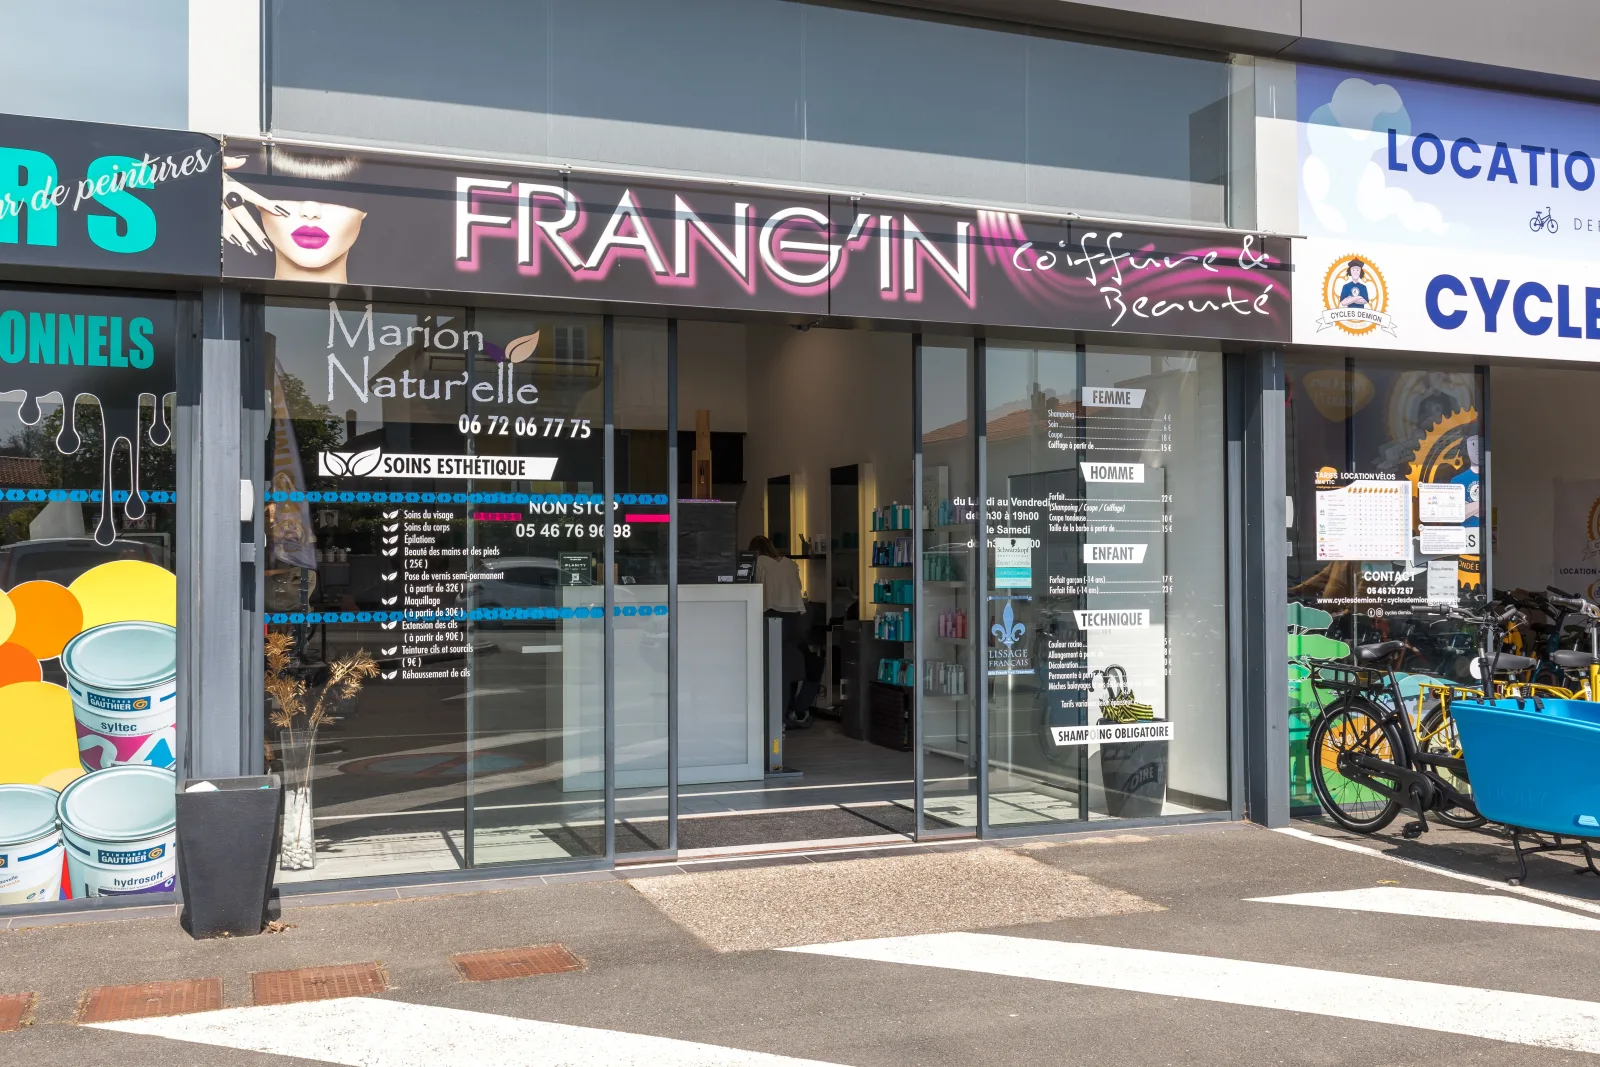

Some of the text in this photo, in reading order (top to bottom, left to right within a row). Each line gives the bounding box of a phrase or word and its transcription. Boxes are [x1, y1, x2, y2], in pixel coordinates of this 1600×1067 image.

[1388, 128, 1595, 191] LOCATIO
[31, 148, 213, 212] de peintures
[455, 176, 974, 304] FRANG'IN
[1013, 232, 1268, 286] Coiffure &
[1100, 284, 1273, 327] Beauté
[1330, 310, 1382, 322] CYCLES DEMION
[327, 301, 483, 352] Marion
[327, 352, 539, 405] Natur'elle
[1092, 390, 1131, 405] FEMME
[1048, 410, 1075, 420] Shampoing
[458, 414, 591, 439] 06 72 06 77 75
[1048, 431, 1063, 440] Coupe
[1048, 440, 1068, 451] Coiffage
[1073, 442, 1087, 451] partir
[384, 456, 526, 476] SOINS ESTHÉTIQUE
[1090, 466, 1134, 480] HOMME
[1341, 472, 1375, 480] LOCATION
[1375, 472, 1396, 480] VÉLOS
[954, 497, 965, 506] du
[968, 497, 994, 506] Ldi
[1010, 498, 1050, 506] Vendredi
[1049, 492, 1065, 500] Forfait
[529, 501, 567, 514] NON
[1083, 504, 1098, 513] Coupe
[404, 510, 454, 520] Soins du visage
[1005, 511, 1009, 520] à
[1013, 512, 1039, 520] 19h00
[1049, 514, 1064, 522] Coupe
[1065, 514, 1086, 522] tondeuse
[404, 523, 450, 533] Soins du corps
[516, 524, 631, 538] 05 46 76 96 98
[986, 525, 1031, 534] le Samedi
[1095, 524, 1108, 533] partir
[404, 533, 436, 544] Épilations
[404, 546, 500, 557] Beauté des mains et des pieds
[1092, 547, 1134, 561] ENFANT
[409, 560, 423, 568] 25€
[404, 571, 504, 583] Pose de vernis semi-permanent
[1066, 576, 1082, 585] garçon
[1364, 571, 1416, 582] CONTACT
[410, 584, 458, 594] à partir de 32€
[404, 596, 440, 607] Maquillage
[1317, 597, 1382, 605] www.cyclesdemion.fr
[409, 608, 458, 619] à partir de 30€
[402, 620, 458, 630] Extension des cils
[1081, 612, 1142, 627] TECHNIQUE
[410, 632, 458, 644] à partir de 90€
[402, 644, 474, 655] Teinture cils et sourcils
[989, 649, 1028, 658] LISSAGE
[407, 658, 416, 667] 9€
[402, 668, 470, 680] Réhaussement de cils
[1067, 682, 1091, 691] balayages
[89, 694, 131, 704] PEINTURES
[90, 698, 131, 710] GAUTHIER
[1061, 700, 1074, 708] Tarifs
[101, 722, 137, 732] syltec
[1058, 726, 1169, 742] SHAMPOING OBLIGATOIRE
[101, 853, 147, 864] GAUTHIER
[114, 870, 164, 888] hydrosoft
